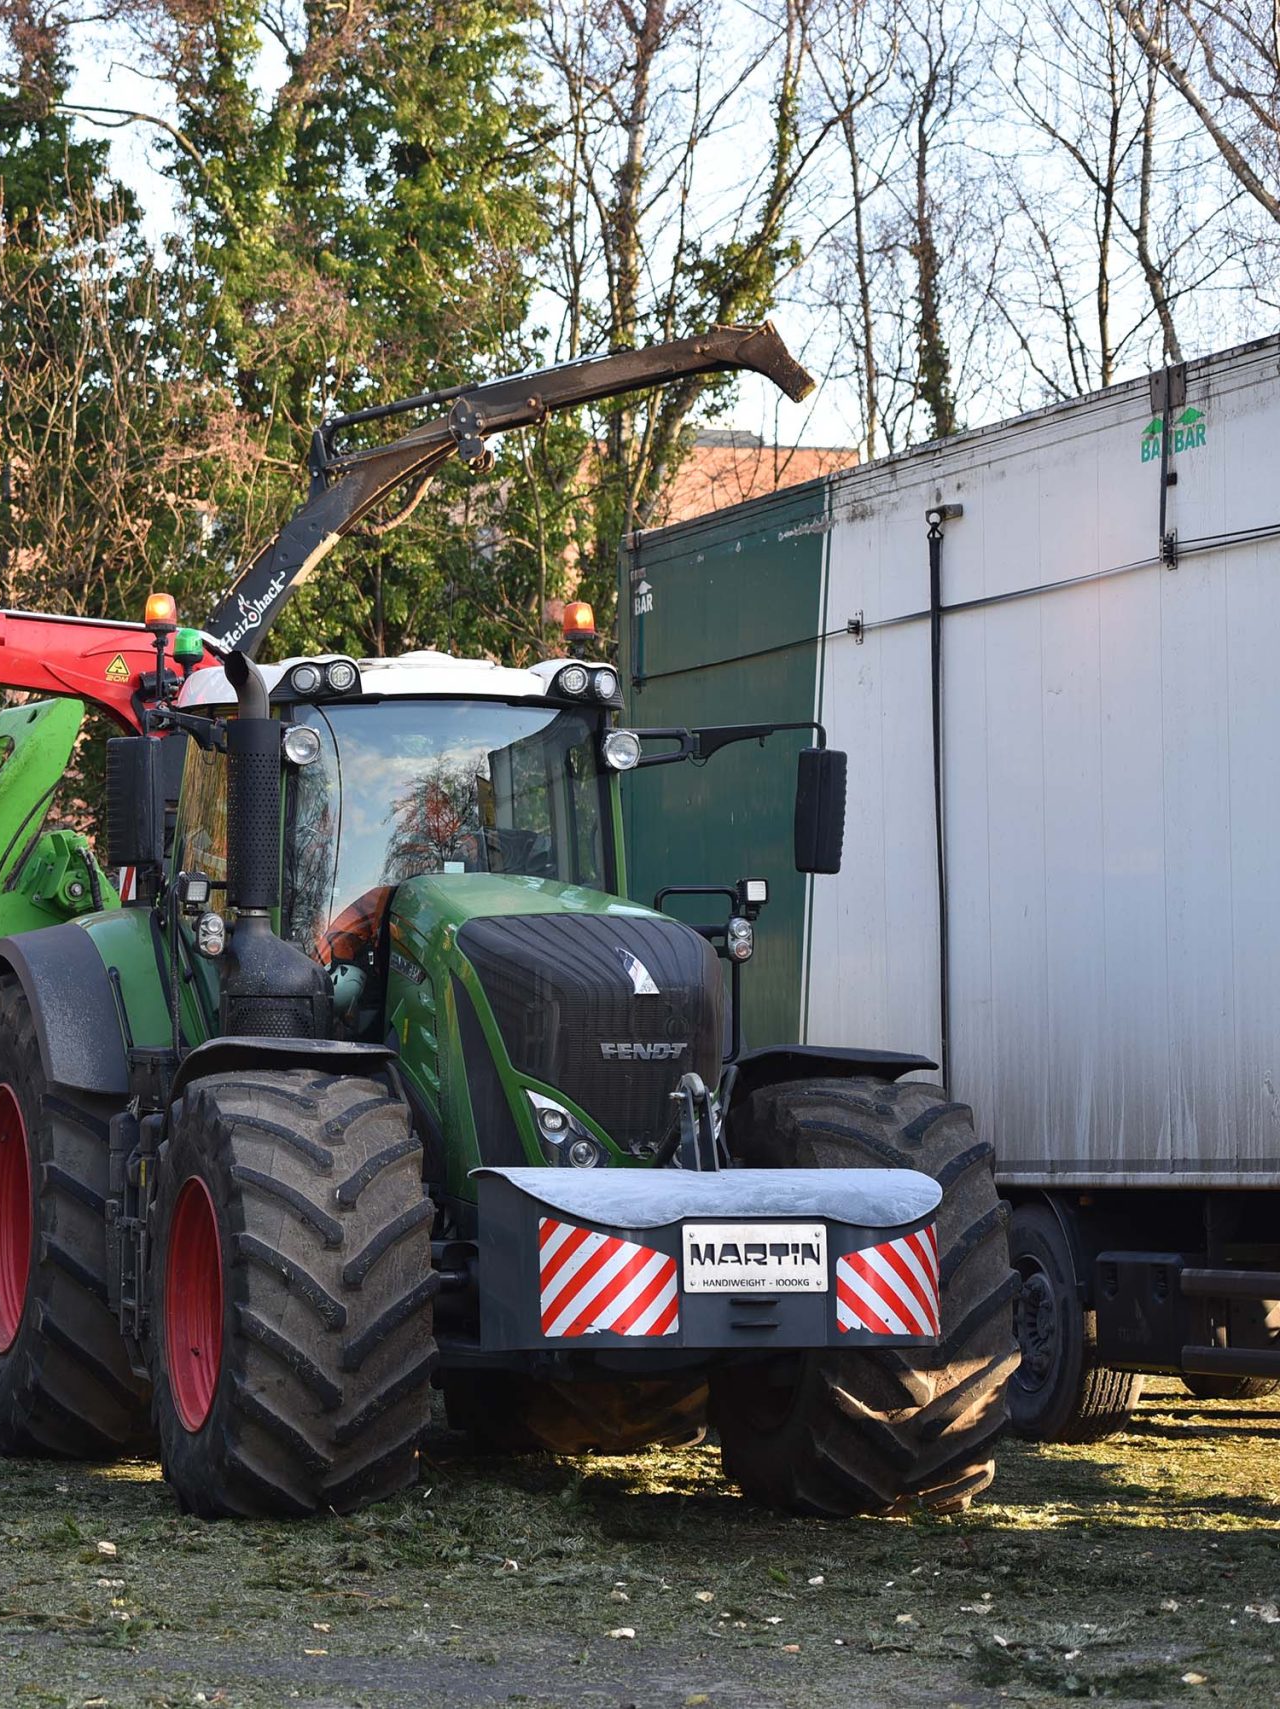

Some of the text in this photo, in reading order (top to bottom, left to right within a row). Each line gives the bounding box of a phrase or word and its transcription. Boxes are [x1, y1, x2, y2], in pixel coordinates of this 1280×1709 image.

[1174, 423, 1207, 453] BAR
[634, 593, 653, 616] BAR
[600, 1042, 688, 1060] FENDT
[690, 1243, 820, 1266] MARTIN
[702, 1278, 766, 1287] HANDIWEIGHT
[775, 1278, 810, 1287] 1000KG
